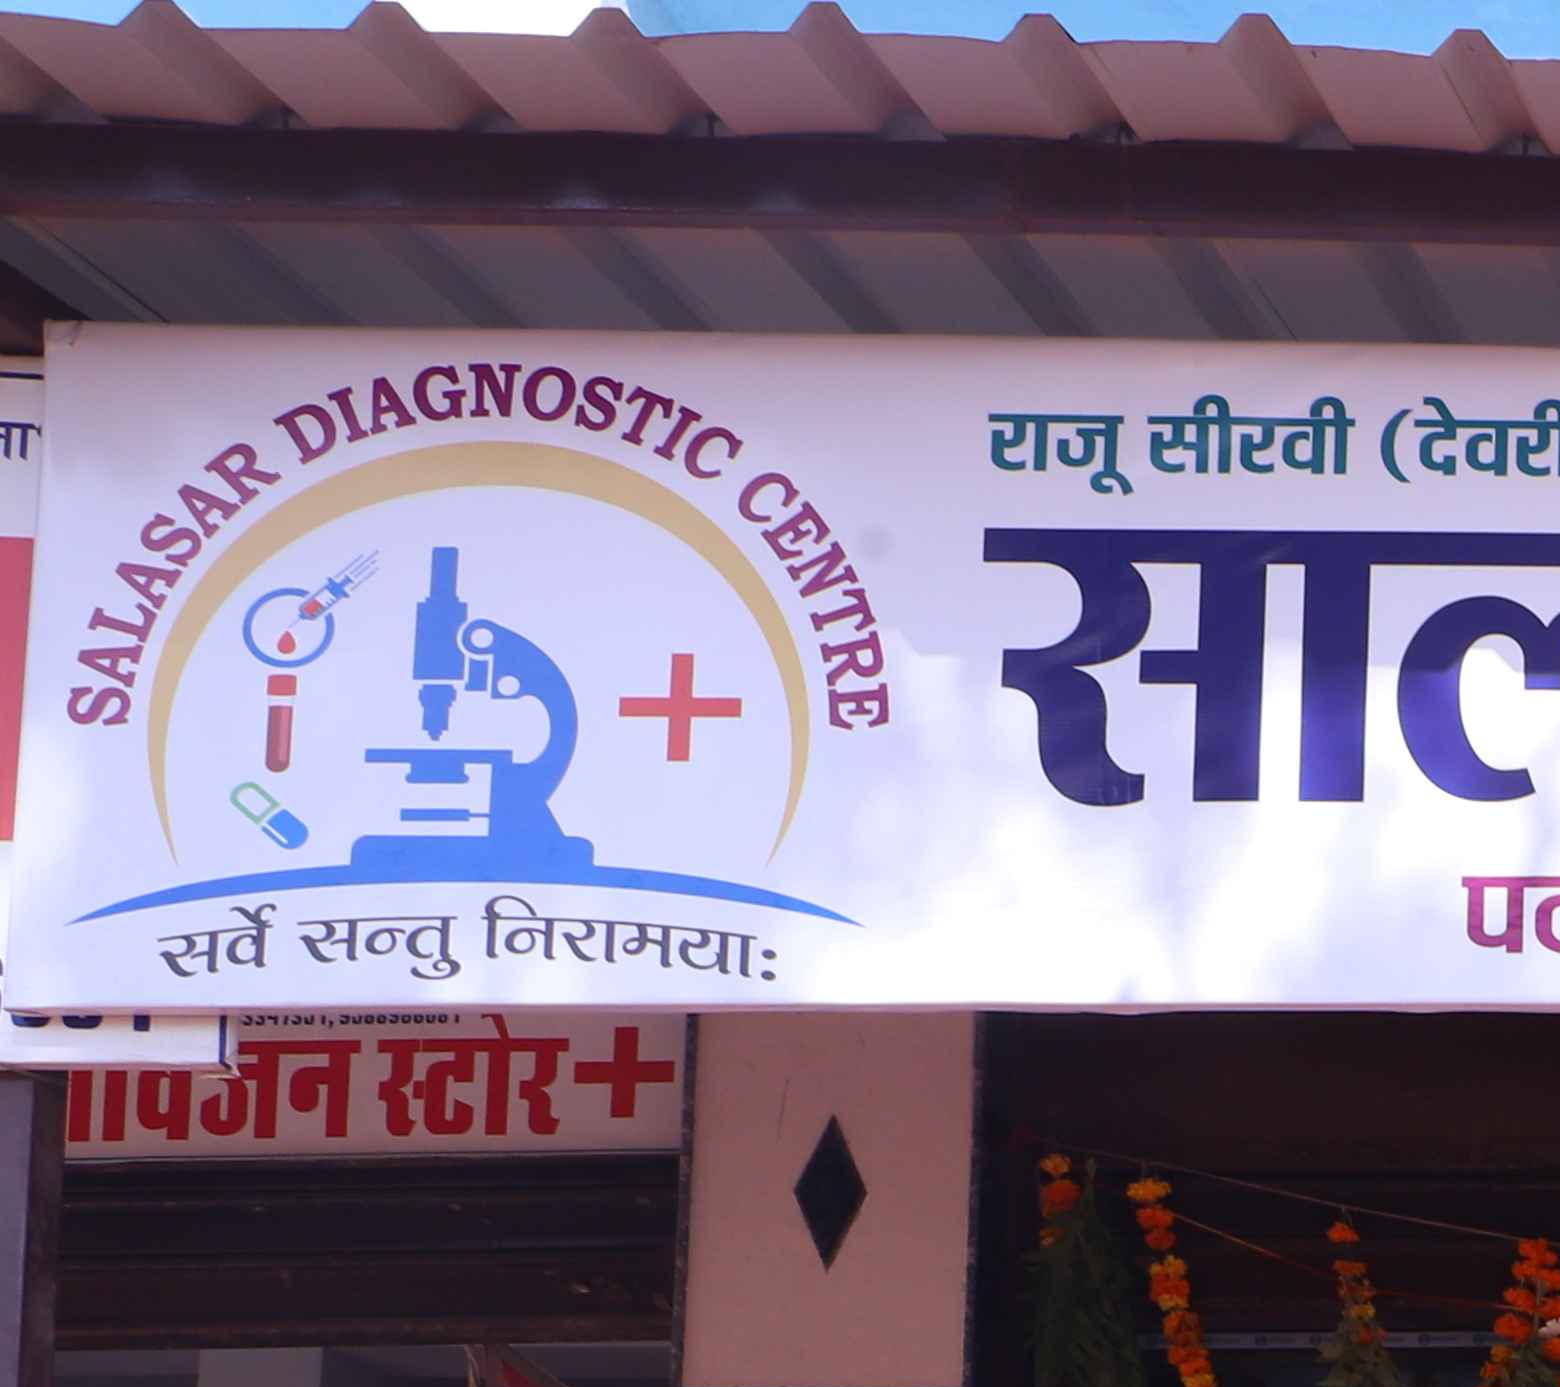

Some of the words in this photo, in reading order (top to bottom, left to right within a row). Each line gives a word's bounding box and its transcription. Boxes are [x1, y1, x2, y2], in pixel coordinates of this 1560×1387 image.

[988, 412, 1134, 495] राजू
[1148, 394, 1356, 476] सीरवी
[66, 440, 281, 728] SALASAR
[274, 362, 743, 478] DIAGNOSTIC
[738, 471, 892, 732] CENTRE
[158, 904, 278, 979] सर्वे
[298, 914, 457, 981] सन्तु
